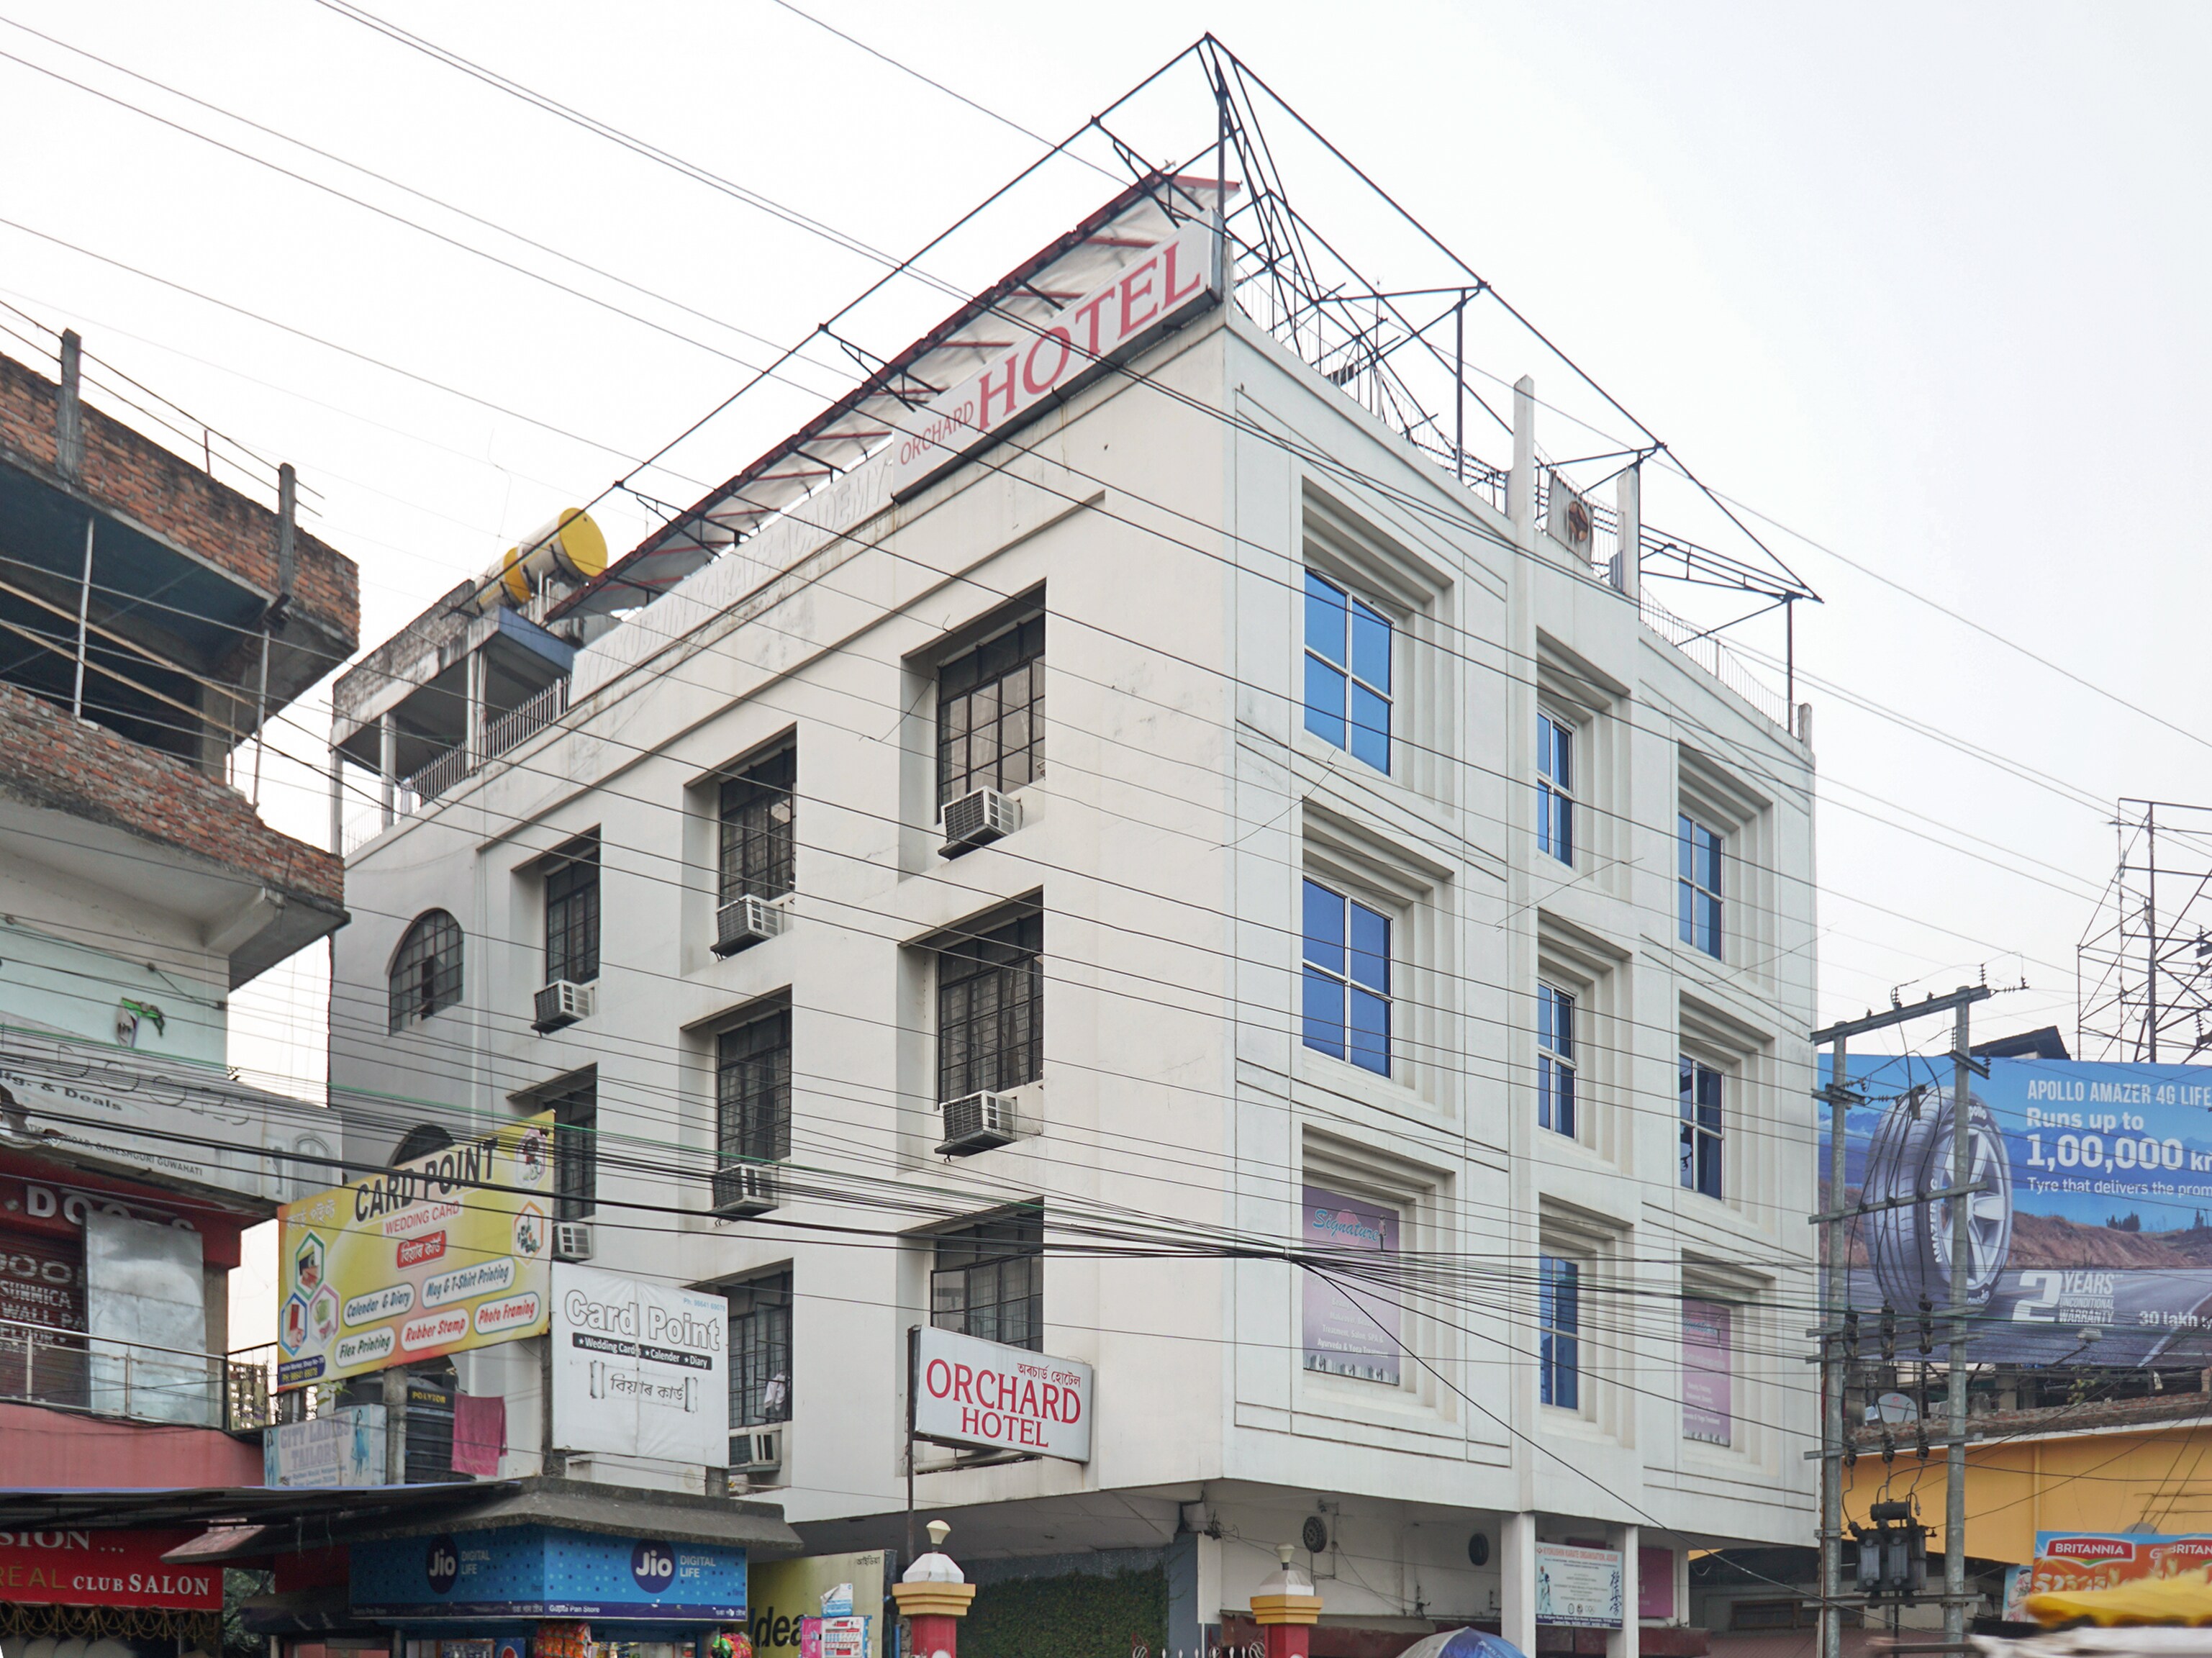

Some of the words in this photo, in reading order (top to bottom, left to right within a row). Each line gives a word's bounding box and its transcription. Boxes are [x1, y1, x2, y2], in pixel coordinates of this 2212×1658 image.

[899, 400, 974, 466] ORCHARD
[976, 241, 1201, 435] HOTEL
[0, 1070, 32, 1087] fg.
[64, 1087, 122, 1111] Deals
[2027, 1079, 2084, 1102] APOLLO
[2089, 1082, 2151, 1104] AMAZER
[2155, 1084, 2175, 1105] 4G
[2181, 1086, 2212, 1107] LIFE
[2026, 1107, 2083, 1128] Runs
[2089, 1113, 2117, 1134] up
[2122, 1112, 2144, 1131] to
[157, 1158, 203, 1177] GUWAHATI
[2026, 1133, 2183, 1174] 1,00,000
[355, 1167, 415, 1223] CARD
[425, 1141, 497, 1200] POINT
[2027, 1177, 2059, 1195] Tyre
[2062, 1178, 2090, 1192] that
[2094, 1179, 2149, 1195] delivers
[2152, 1181, 2174, 1195] the
[386, 1210, 430, 1236] WEDDING
[432, 1200, 460, 1221] CARD
[1312, 1208, 1380, 1242] Signature
[451, 1270, 476, 1291] T-Shirt
[477, 1264, 509, 1283] Printing
[2064, 1270, 2114, 1295] YEARS
[390, 1290, 412, 1308] Diary
[2012, 1269, 2063, 1324] 2
[2059, 1297, 2115, 1309] UNCONDITIONAL
[478, 1307, 502, 1325] Photo
[503, 1299, 535, 1320] Framing
[564, 1289, 640, 1337] Card
[648, 1305, 720, 1351] Point
[2059, 1309, 2115, 1323] WARRANTY
[2139, 1310, 2159, 1326] 30
[2163, 1311, 2198, 1327] lakh
[404, 1323, 437, 1343] Rubber
[437, 1317, 466, 1336] Stamp
[1317, 1338, 1342, 1350] Ayurveda
[339, 1342, 356, 1359] Flex
[358, 1333, 391, 1354] Printing
[584, 1336, 618, 1354] Wedding
[651, 1349, 681, 1363] Calender
[689, 1355, 708, 1370] Diary
[926, 1358, 1081, 1424] ORCHARD
[280, 1426, 307, 1449] CITY
[309, 1414, 351, 1444] LADIES
[961, 1406, 1049, 1448] HOTEL
[291, 1440, 340, 1469] TAILORS
[429, 1549, 456, 1577] Jio
[461, 1549, 491, 1562] DIGITAL
[635, 1549, 673, 1577] Jio
[679, 1555, 716, 1567] DIGITAL
[2054, 1543, 2124, 1555] BRITANNIA
[0, 1561, 67, 1590] ÉAL
[73, 1576, 124, 1592] CLUB
[128, 1573, 210, 1595] SALON
[461, 1563, 478, 1575] LIFE
[679, 1567, 700, 1578] LIFE
